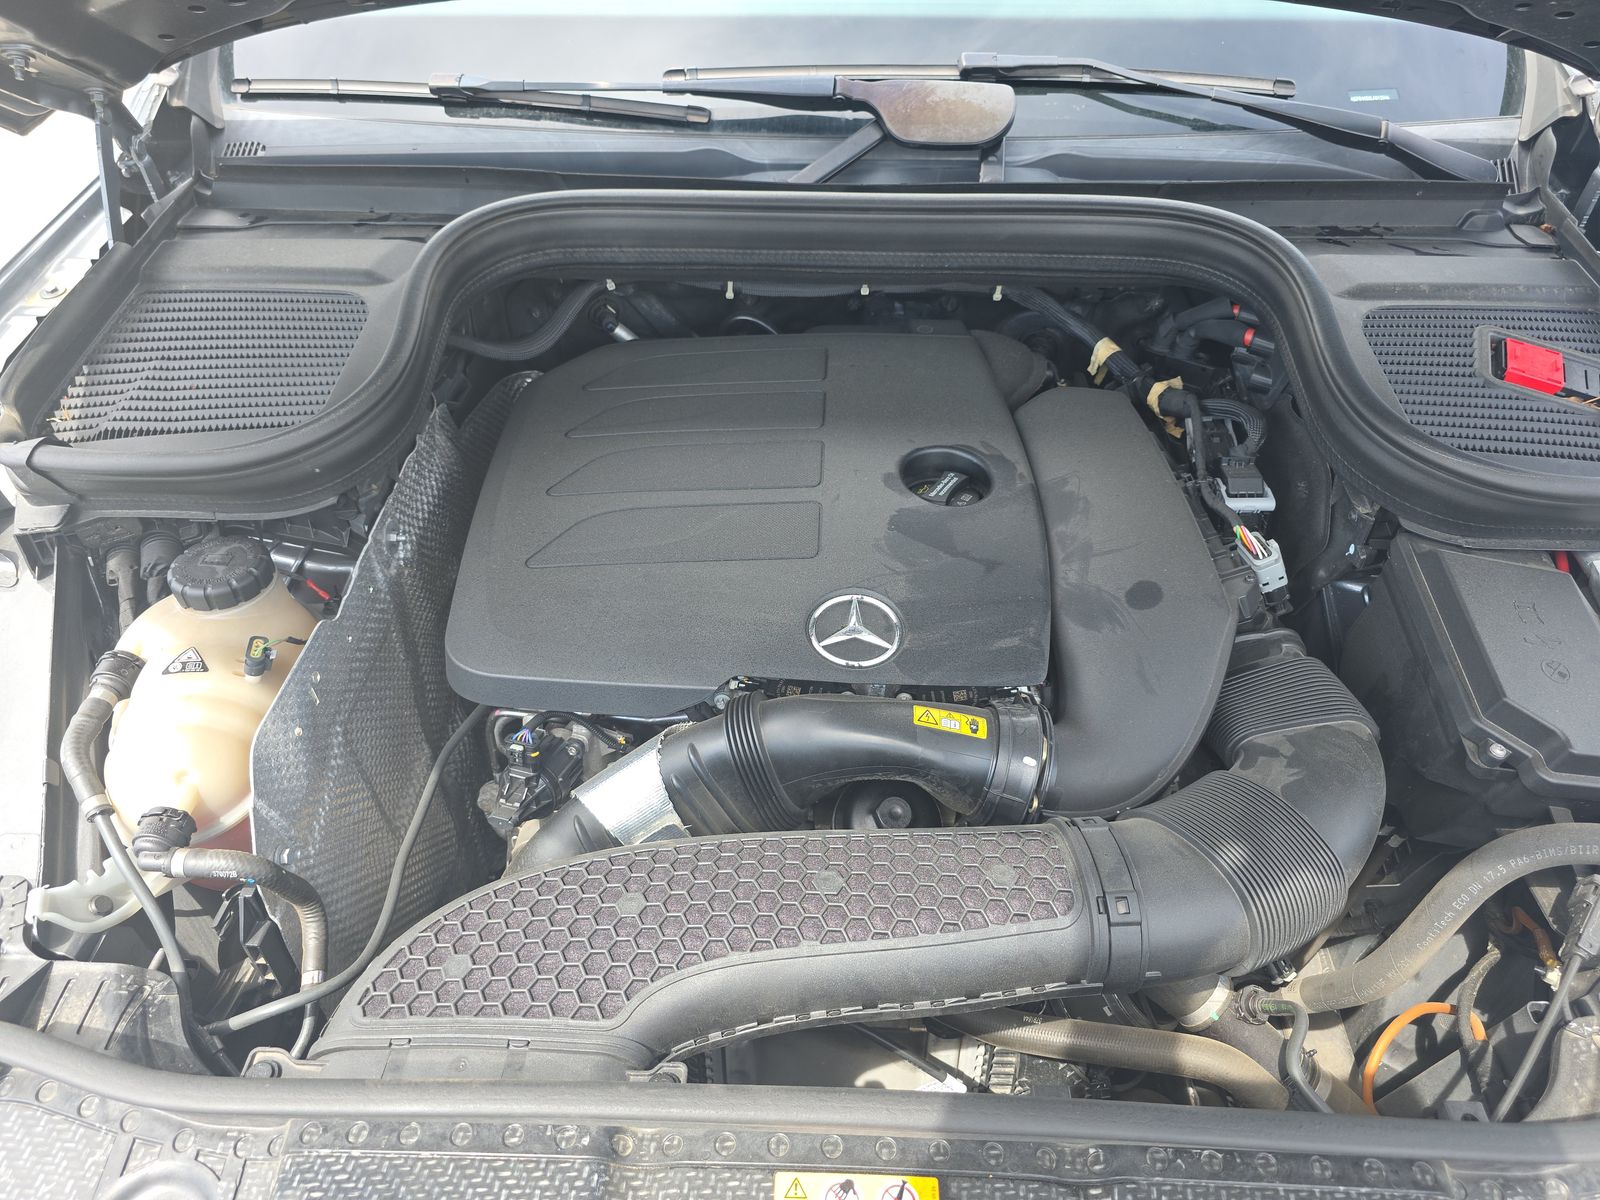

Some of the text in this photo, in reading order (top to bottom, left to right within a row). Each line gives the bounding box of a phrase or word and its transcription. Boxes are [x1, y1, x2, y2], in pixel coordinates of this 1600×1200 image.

[1416, 911, 1455, 951] ContiTech
[1452, 890, 1471, 910] ECO
[1468, 882, 1483, 895] DN
[1483, 864, 1507, 883] 17.5
